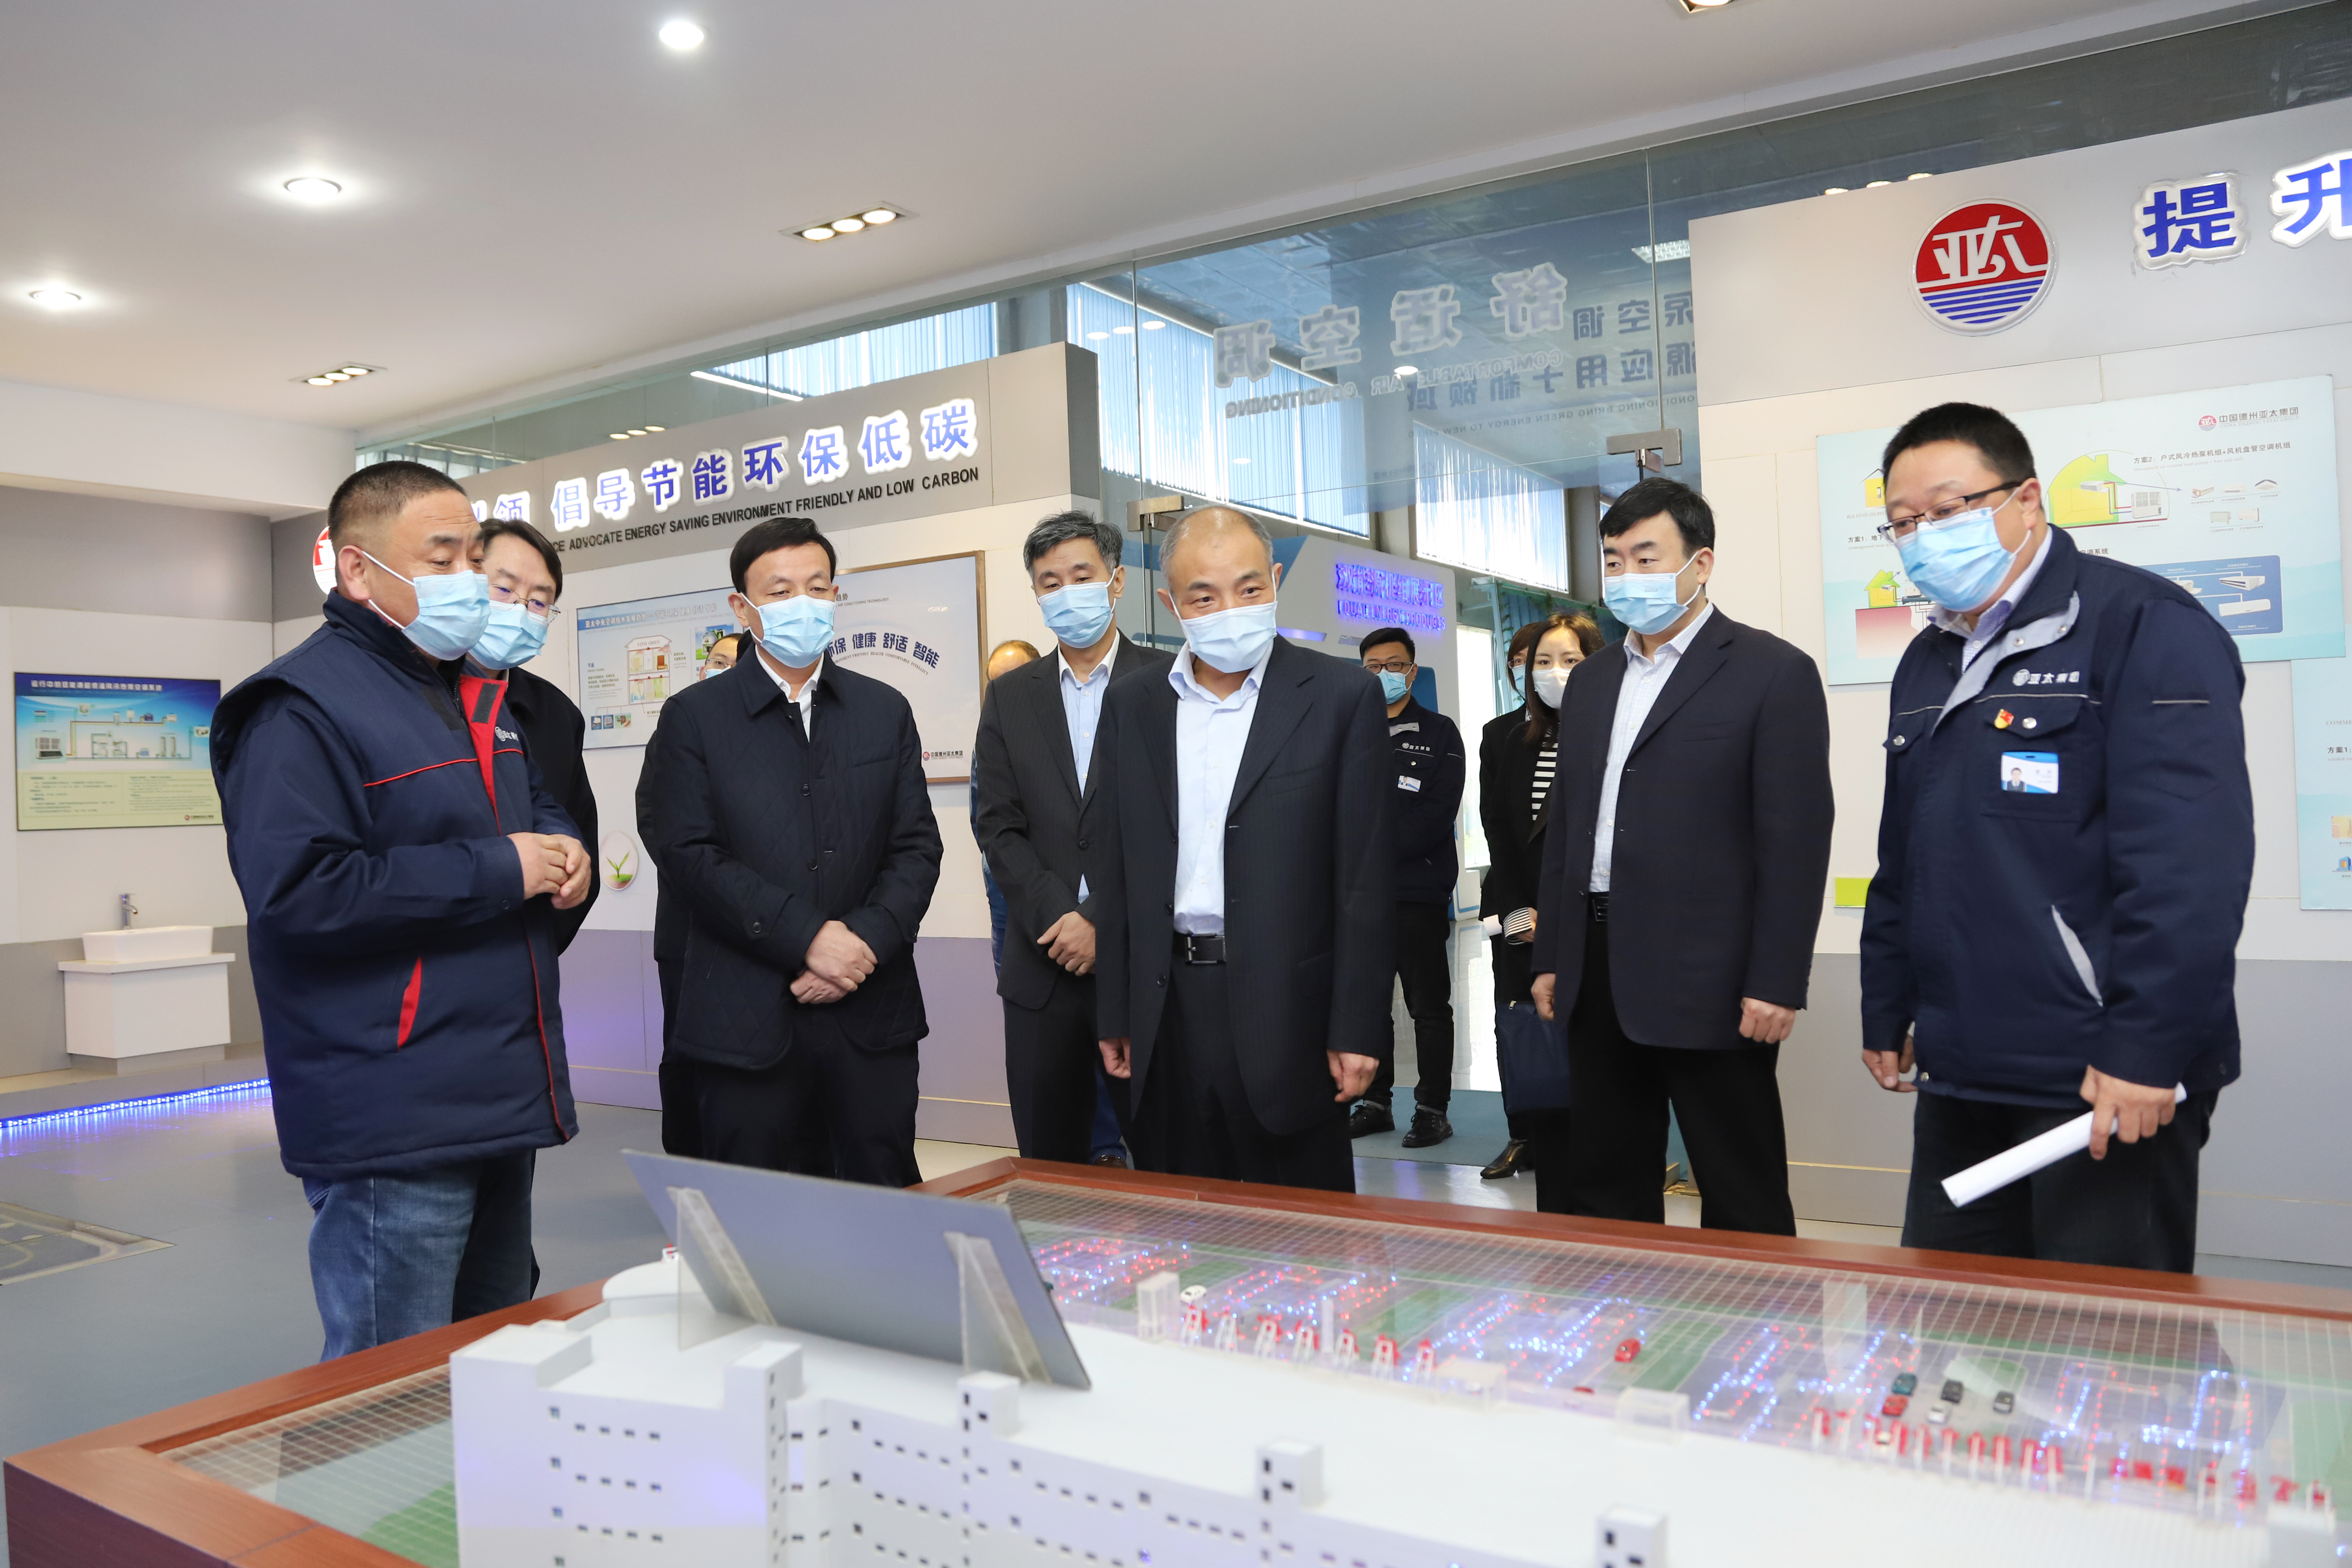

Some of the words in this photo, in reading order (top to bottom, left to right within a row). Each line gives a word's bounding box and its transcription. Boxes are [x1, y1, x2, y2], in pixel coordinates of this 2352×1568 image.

[2142, 158, 2352, 258] 提升
[2219, 407, 2299, 423] 中国德州亚太集团
[553, 404, 970, 525] 倡导节能环保低碳
[569, 530, 622, 550] ADVOCATE
[625, 522, 666, 541] ENERGY
[669, 514, 709, 533] SAVING
[712, 500, 793, 526] ENVIRONMENT
[796, 489, 854, 512] FRIENDLY
[858, 485, 882, 502] AND
[887, 479, 915, 496] LOW
[922, 467, 979, 490] CARBON
[1339, 600, 1367, 618] DUAL
[1402, 609, 1447, 631] PRODUCTS
[852, 632, 876, 649] 健康
[883, 632, 908, 653] 舒适
[913, 641, 940, 669] 智能
[885, 652, 910, 664] COMFORTABLE
[911, 662, 929, 675] INTELLECT
